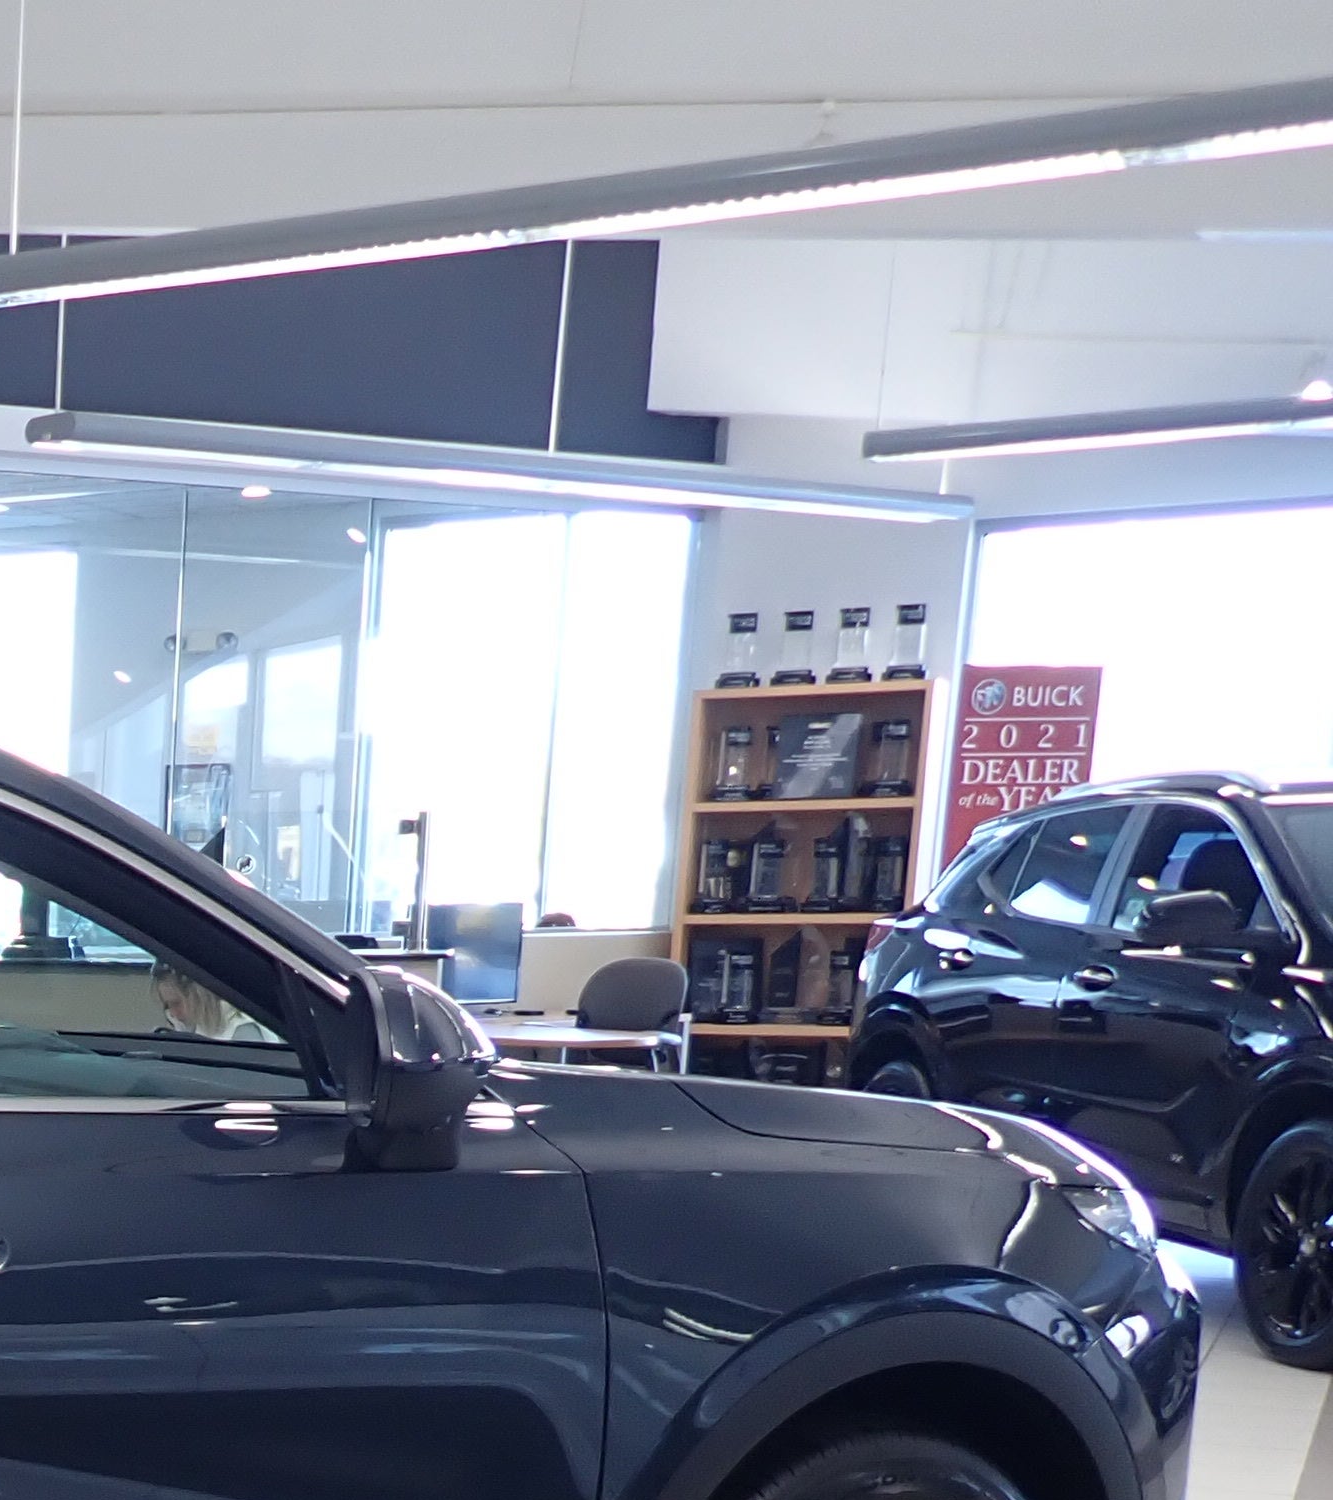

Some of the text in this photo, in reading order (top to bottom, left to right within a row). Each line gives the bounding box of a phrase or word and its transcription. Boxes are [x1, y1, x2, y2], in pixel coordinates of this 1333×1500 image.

[1012, 686, 1084, 707] BUICK
[960, 759, 1081, 785] DEALER
[958, 786, 1069, 811] of the YEA
